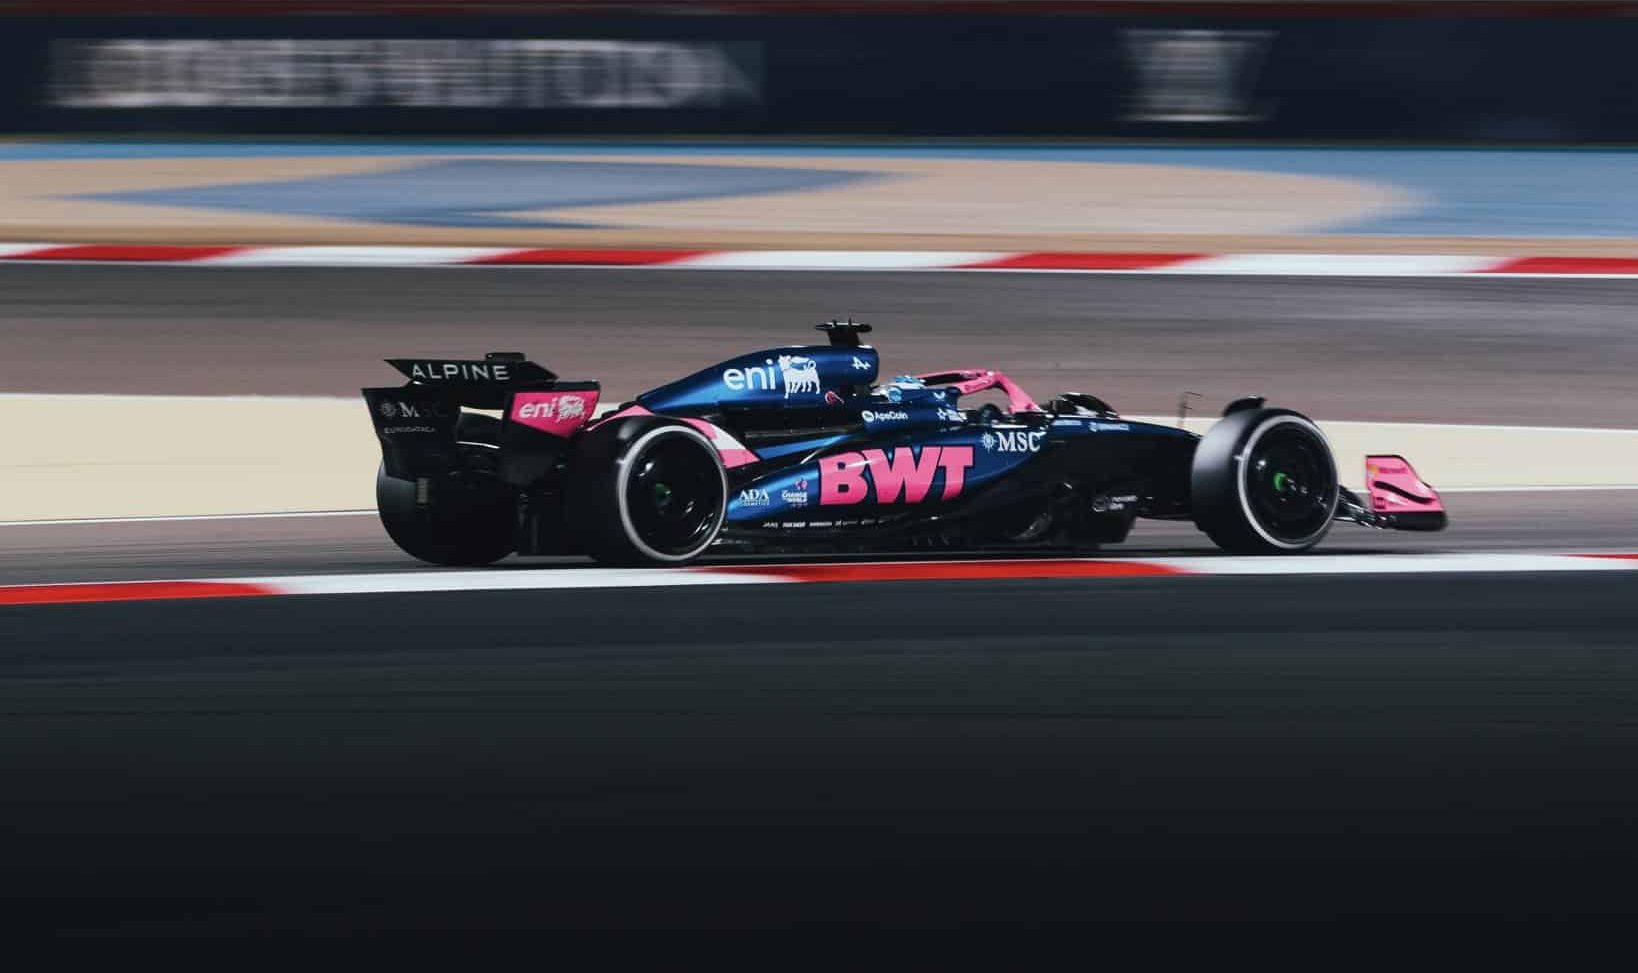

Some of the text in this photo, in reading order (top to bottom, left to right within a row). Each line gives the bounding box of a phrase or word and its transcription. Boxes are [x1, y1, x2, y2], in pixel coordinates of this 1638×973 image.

[412, 363, 511, 380] ALPINE
[723, 358, 776, 391] eni
[519, 397, 557, 418] eni
[997, 431, 1041, 451] MSC
[818, 445, 975, 506] BWT
